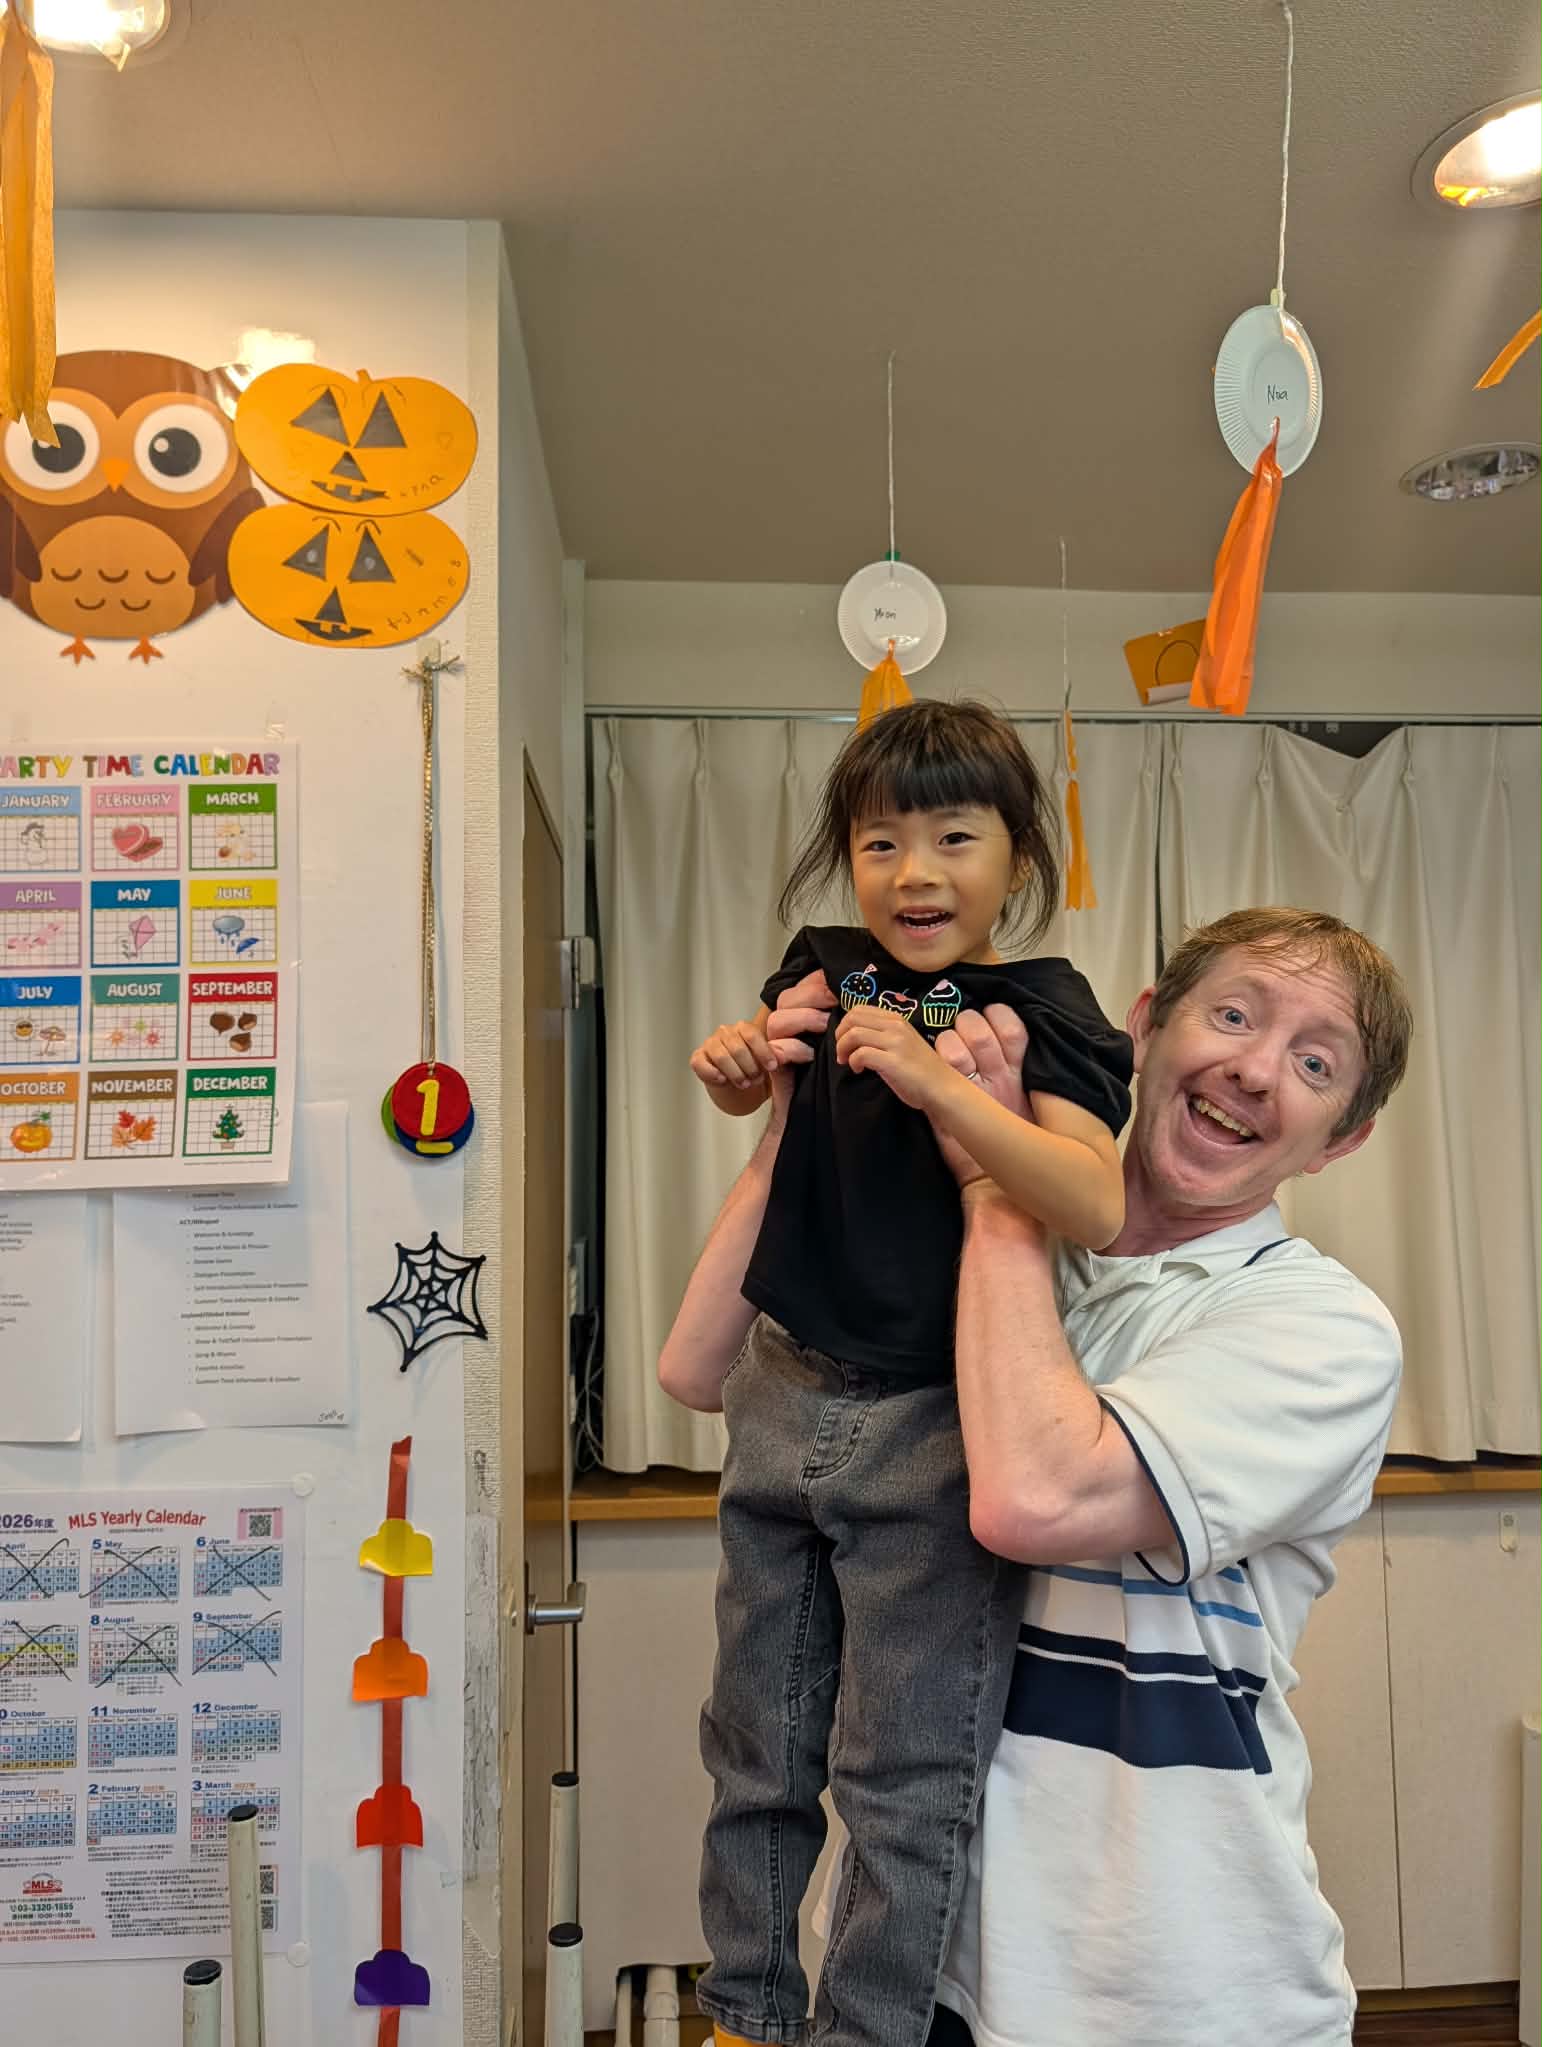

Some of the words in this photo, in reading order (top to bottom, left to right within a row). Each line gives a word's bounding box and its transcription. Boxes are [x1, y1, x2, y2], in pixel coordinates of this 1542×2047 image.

[0, 755, 73, 778] ARTY
[83, 754, 145, 778] TIME
[154, 753, 281, 777] CALENDAR
[2, 794, 71, 808] JANUARY
[97, 793, 172, 807] FEBRUARY
[206, 792, 260, 805] MARCH
[15, 888, 57, 903] APRIL
[117, 887, 151, 901] MAY
[215, 887, 252, 899] JUNE
[18, 985, 53, 999] JULY
[106, 982, 163, 997] AUGUST
[192, 981, 273, 996] SEPTEMBER
[1, 1081, 66, 1095] OCTOBER
[91, 1078, 173, 1093] NOVEMBER
[193, 1076, 267, 1091] DECEMBER
[416, 1079, 440, 1136] 1
[0, 1514, 55, 1529] 026年度
[68, 1512, 97, 1529] MLS
[100, 1509, 142, 1527] Yearly
[145, 1509, 206, 1526] Calendar
[92, 1539, 102, 1549] 5
[105, 1541, 122, 1549] May
[196, 1536, 206, 1547] 6
[90, 1615, 100, 1625] 8
[103, 1616, 134, 1624] August
[193, 1612, 203, 1622] 9
[91, 1706, 107, 1716] 11
[192, 1702, 211, 1712] 12
[214, 1703, 258, 1711] December
[88, 1784, 99, 1794] 2
[101, 1785, 140, 1793] February
[192, 1780, 202, 1791] 3
[31, 1879, 54, 1889] MLS
